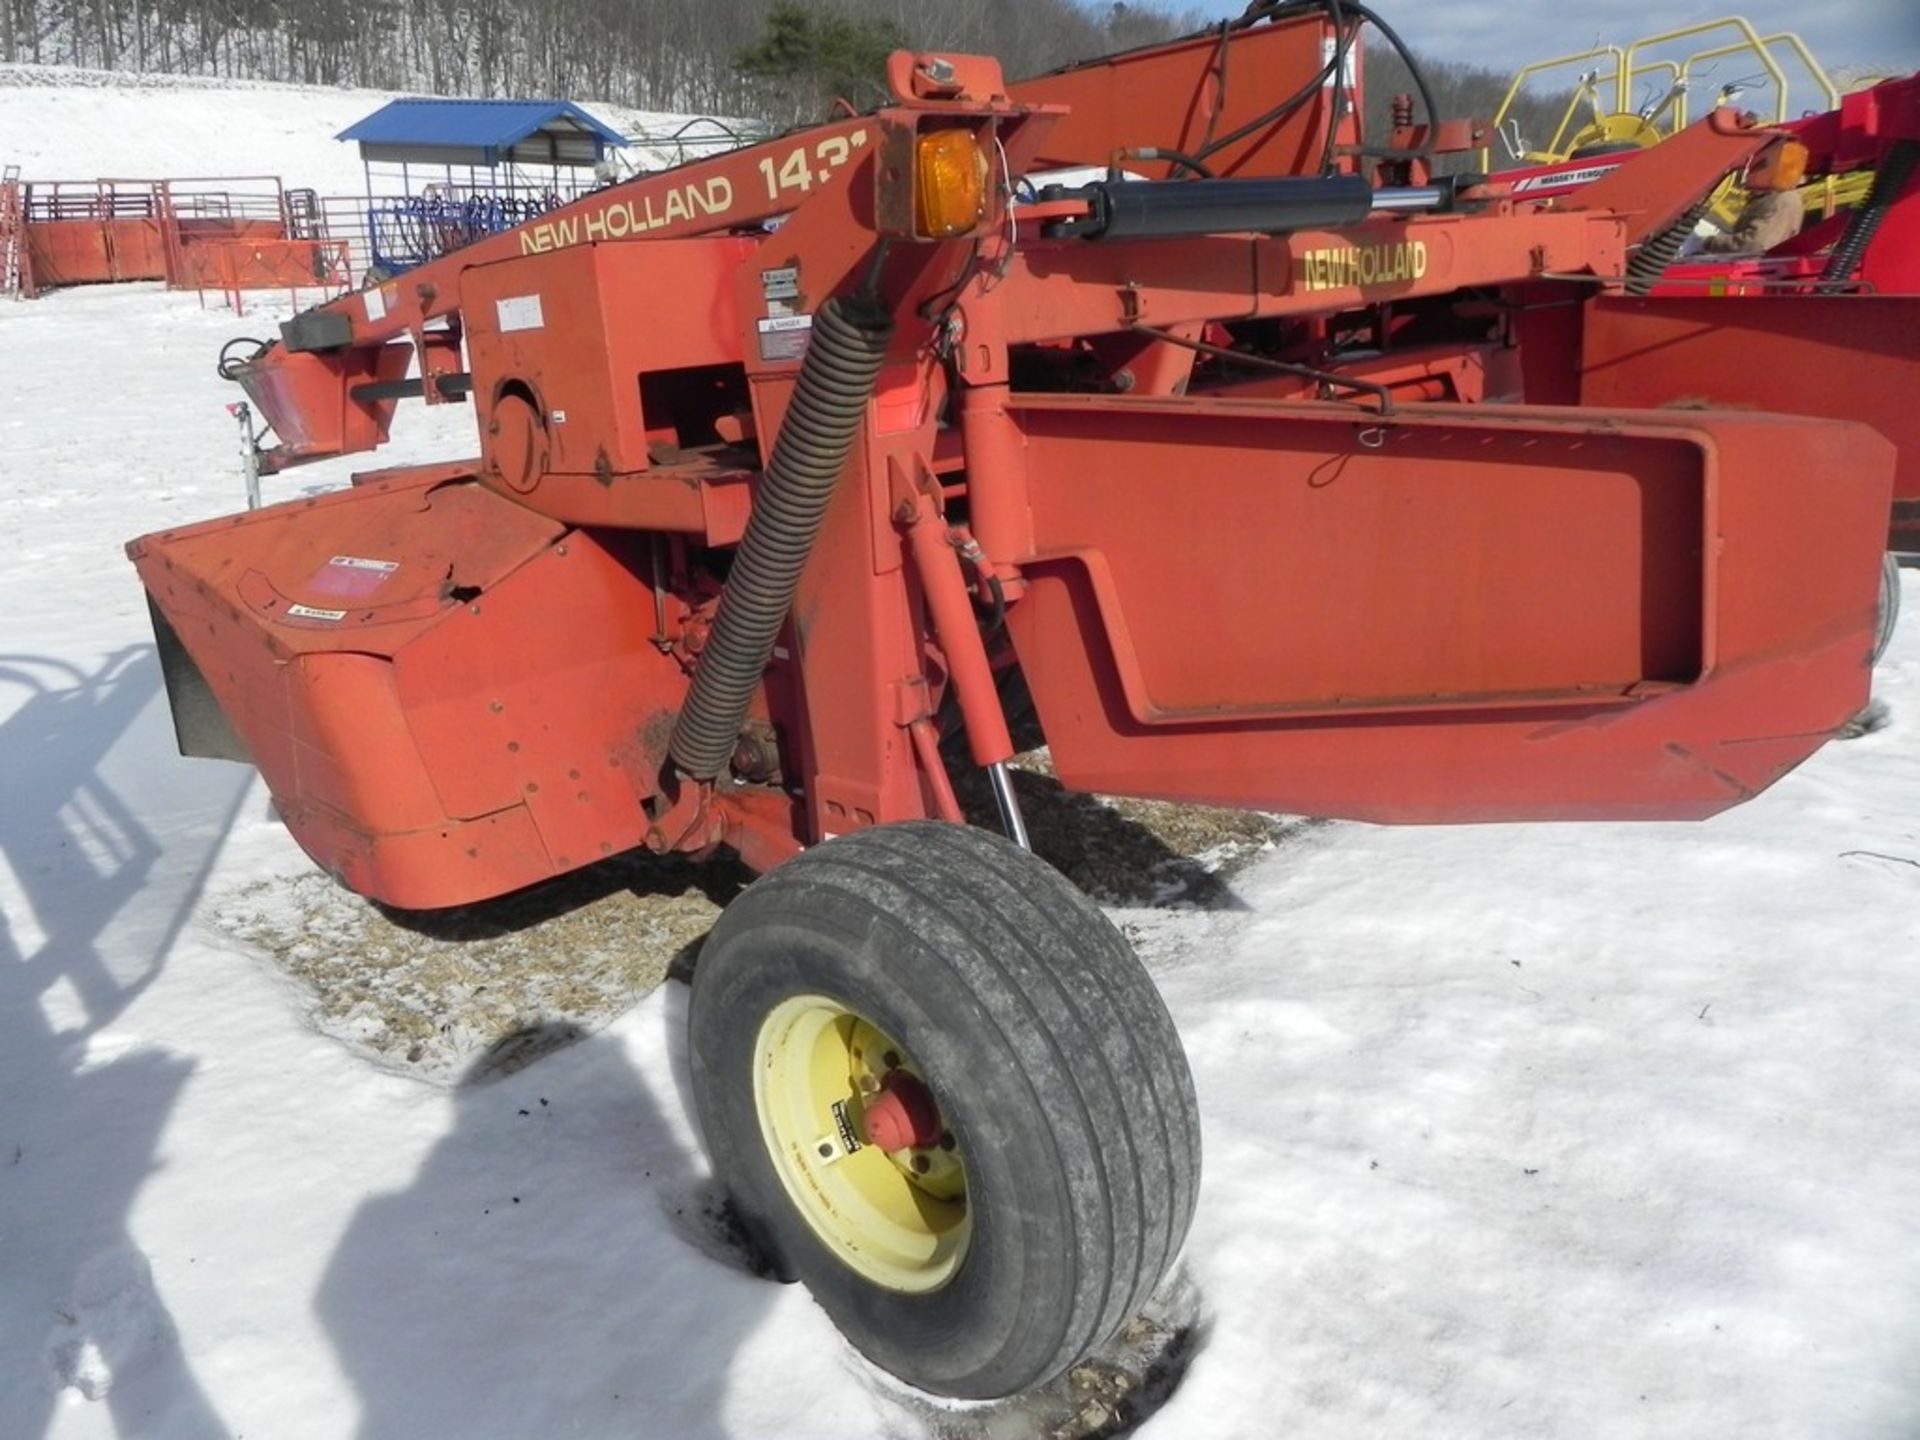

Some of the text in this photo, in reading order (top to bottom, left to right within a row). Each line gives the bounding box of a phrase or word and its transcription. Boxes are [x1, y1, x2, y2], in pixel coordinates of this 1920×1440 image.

[519, 130, 867, 256] NEW HOLLAND 143
[1305, 241, 1426, 291] NEW HOLLAND
